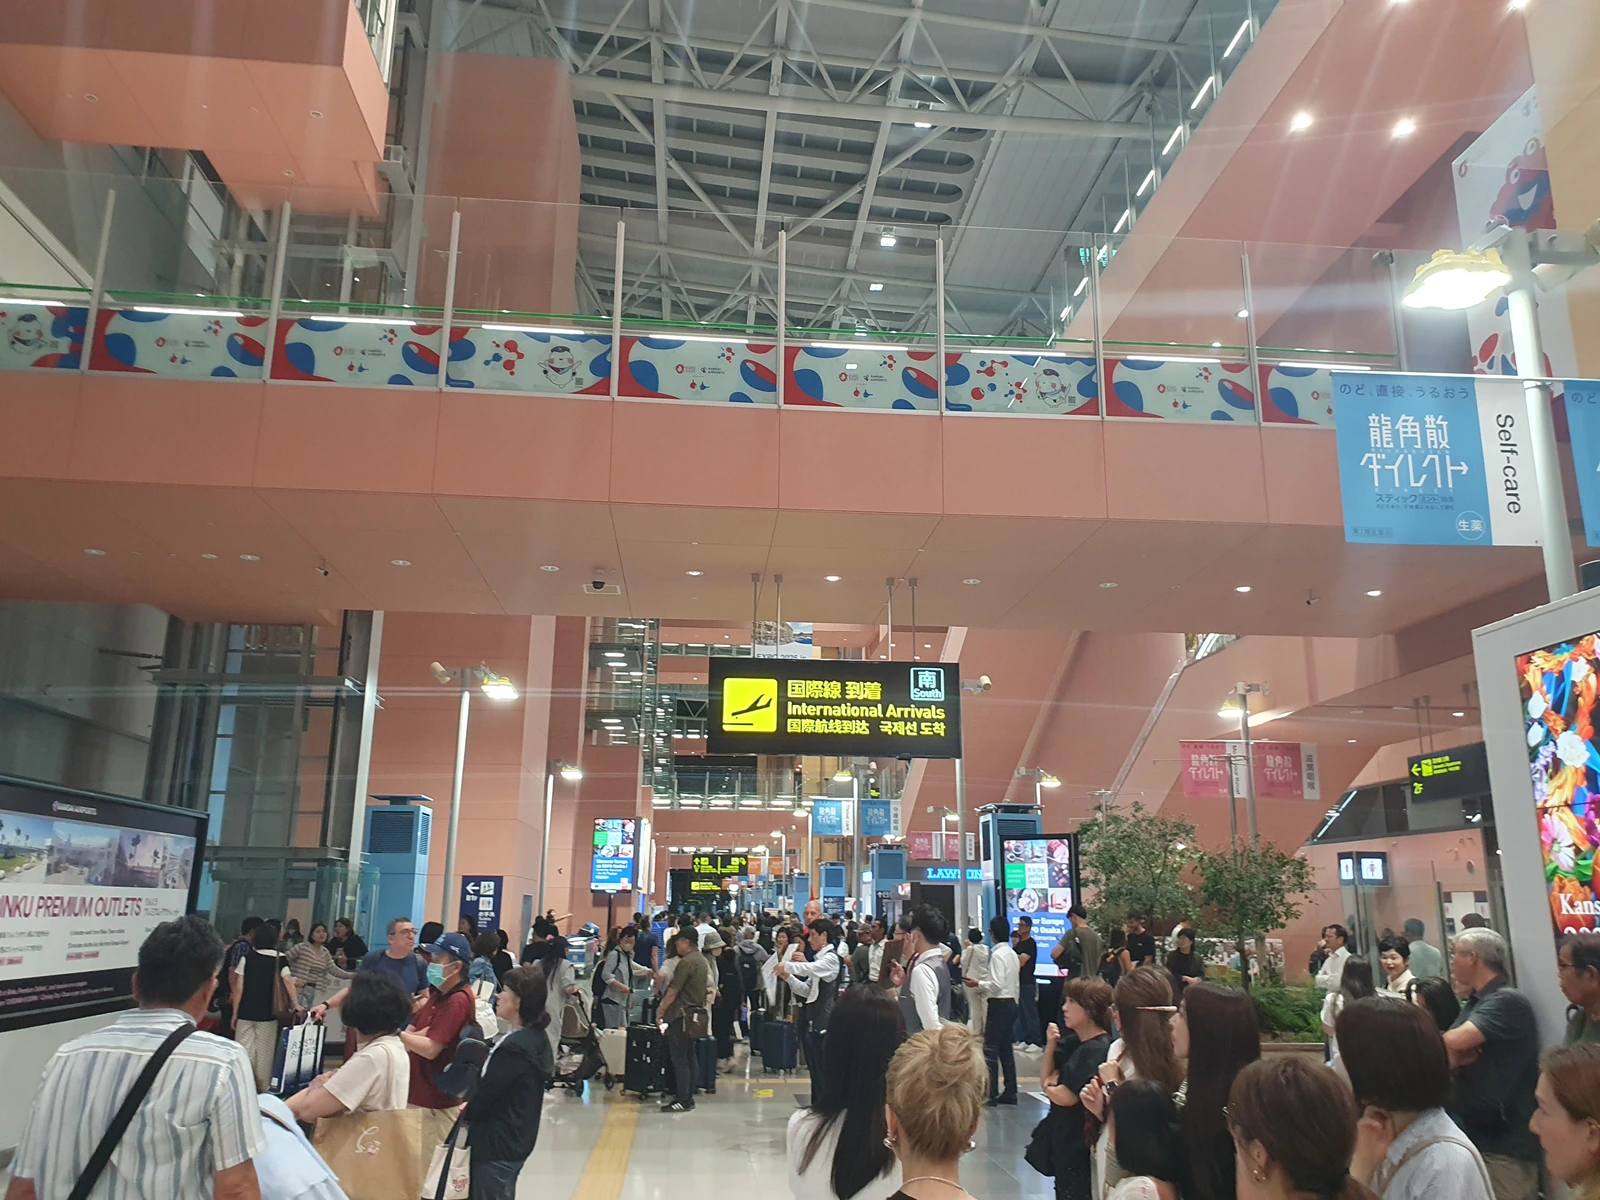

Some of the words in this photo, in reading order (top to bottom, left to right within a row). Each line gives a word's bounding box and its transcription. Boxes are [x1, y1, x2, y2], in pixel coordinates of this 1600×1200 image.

[1368, 413, 1451, 450] 龍角散
[1496, 413, 1522, 514] Self-care
[1458, 520, 1482, 532] 生薬
[918, 670, 936, 688] 南
[787, 680, 842, 698] 国際線
[845, 681, 882, 700] 到着
[914, 688, 942, 698] South
[788, 701, 884, 718] International
[886, 704, 946, 719] Arrivals
[879, 721, 918, 736] 국제선
[920, 722, 946, 736] 도착
[35, 896, 94, 917] PREMIUM
[94, 896, 142, 917] OUTLETS
